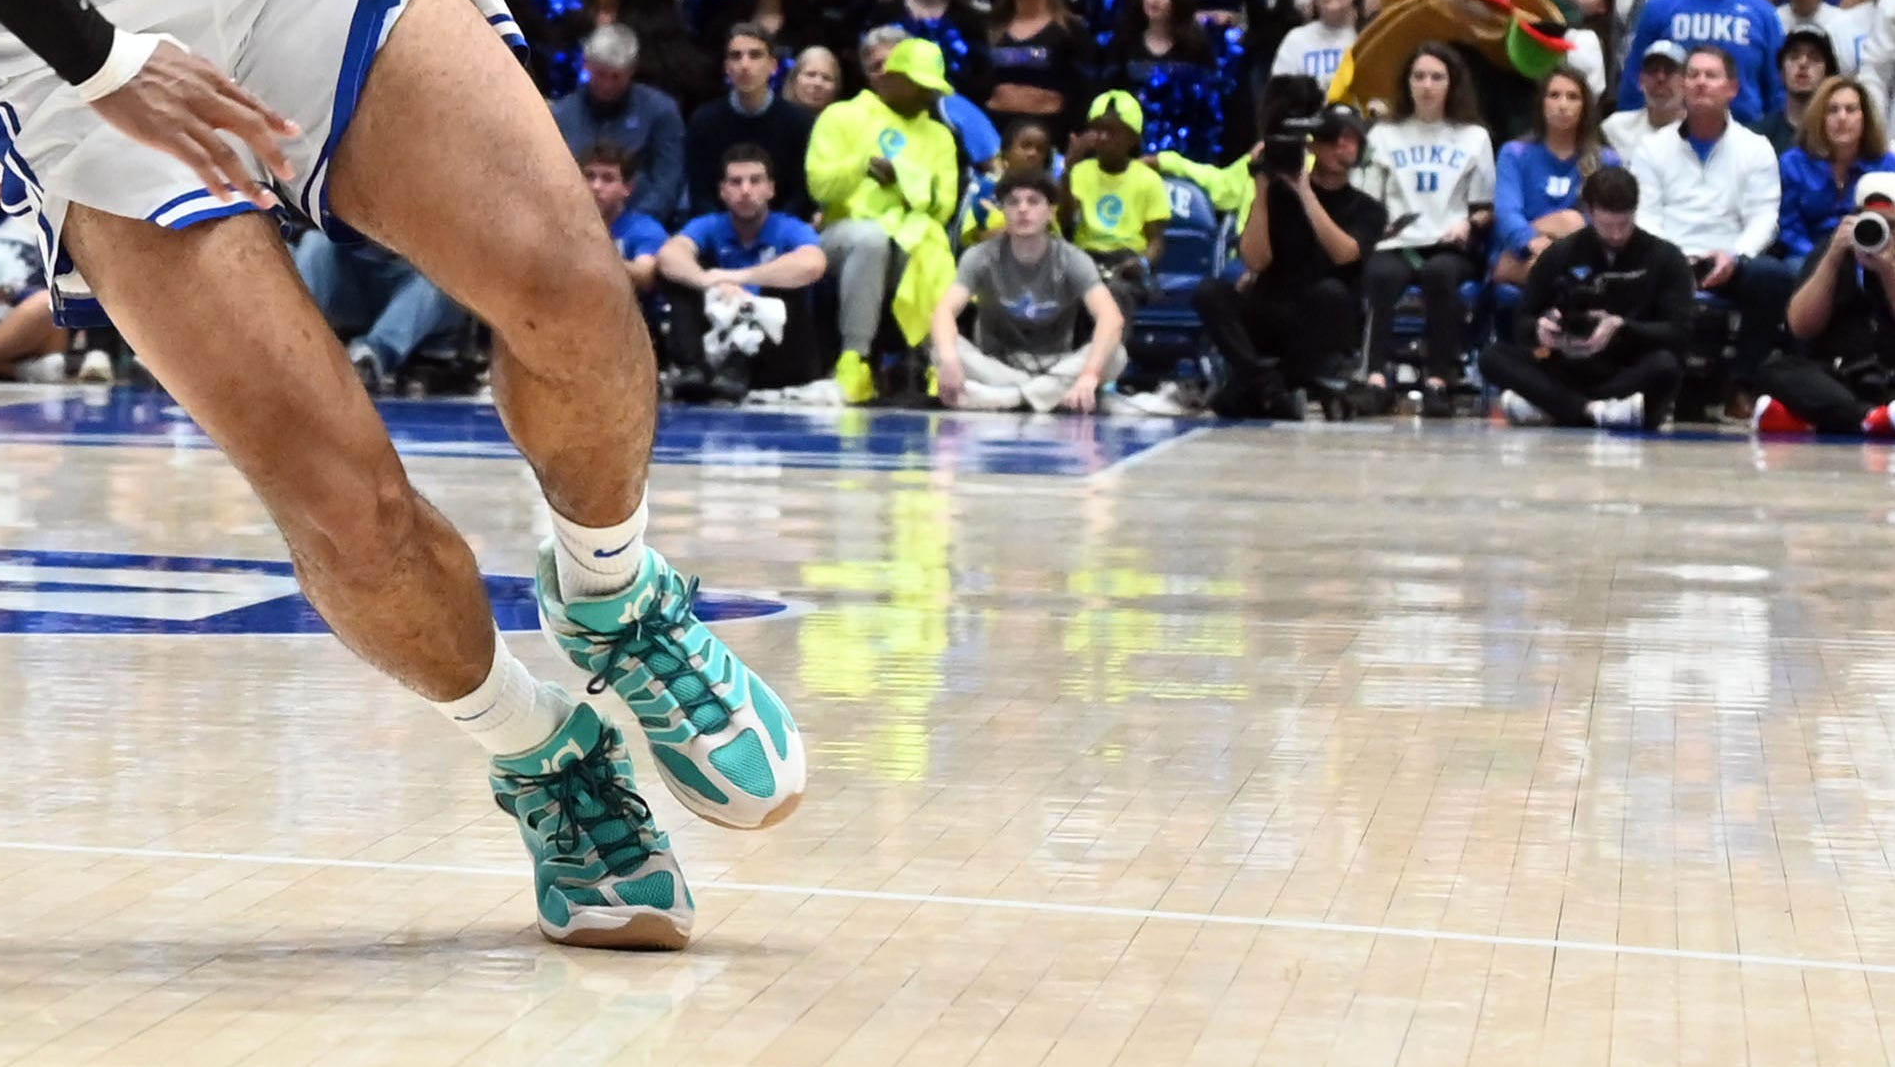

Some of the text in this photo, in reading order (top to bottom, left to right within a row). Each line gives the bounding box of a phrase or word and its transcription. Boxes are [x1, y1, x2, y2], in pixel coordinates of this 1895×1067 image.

[1671, 13, 1751, 45] DUKE
[1304, 48, 1342, 76] DU
[1391, 144, 1467, 169] DUKE
